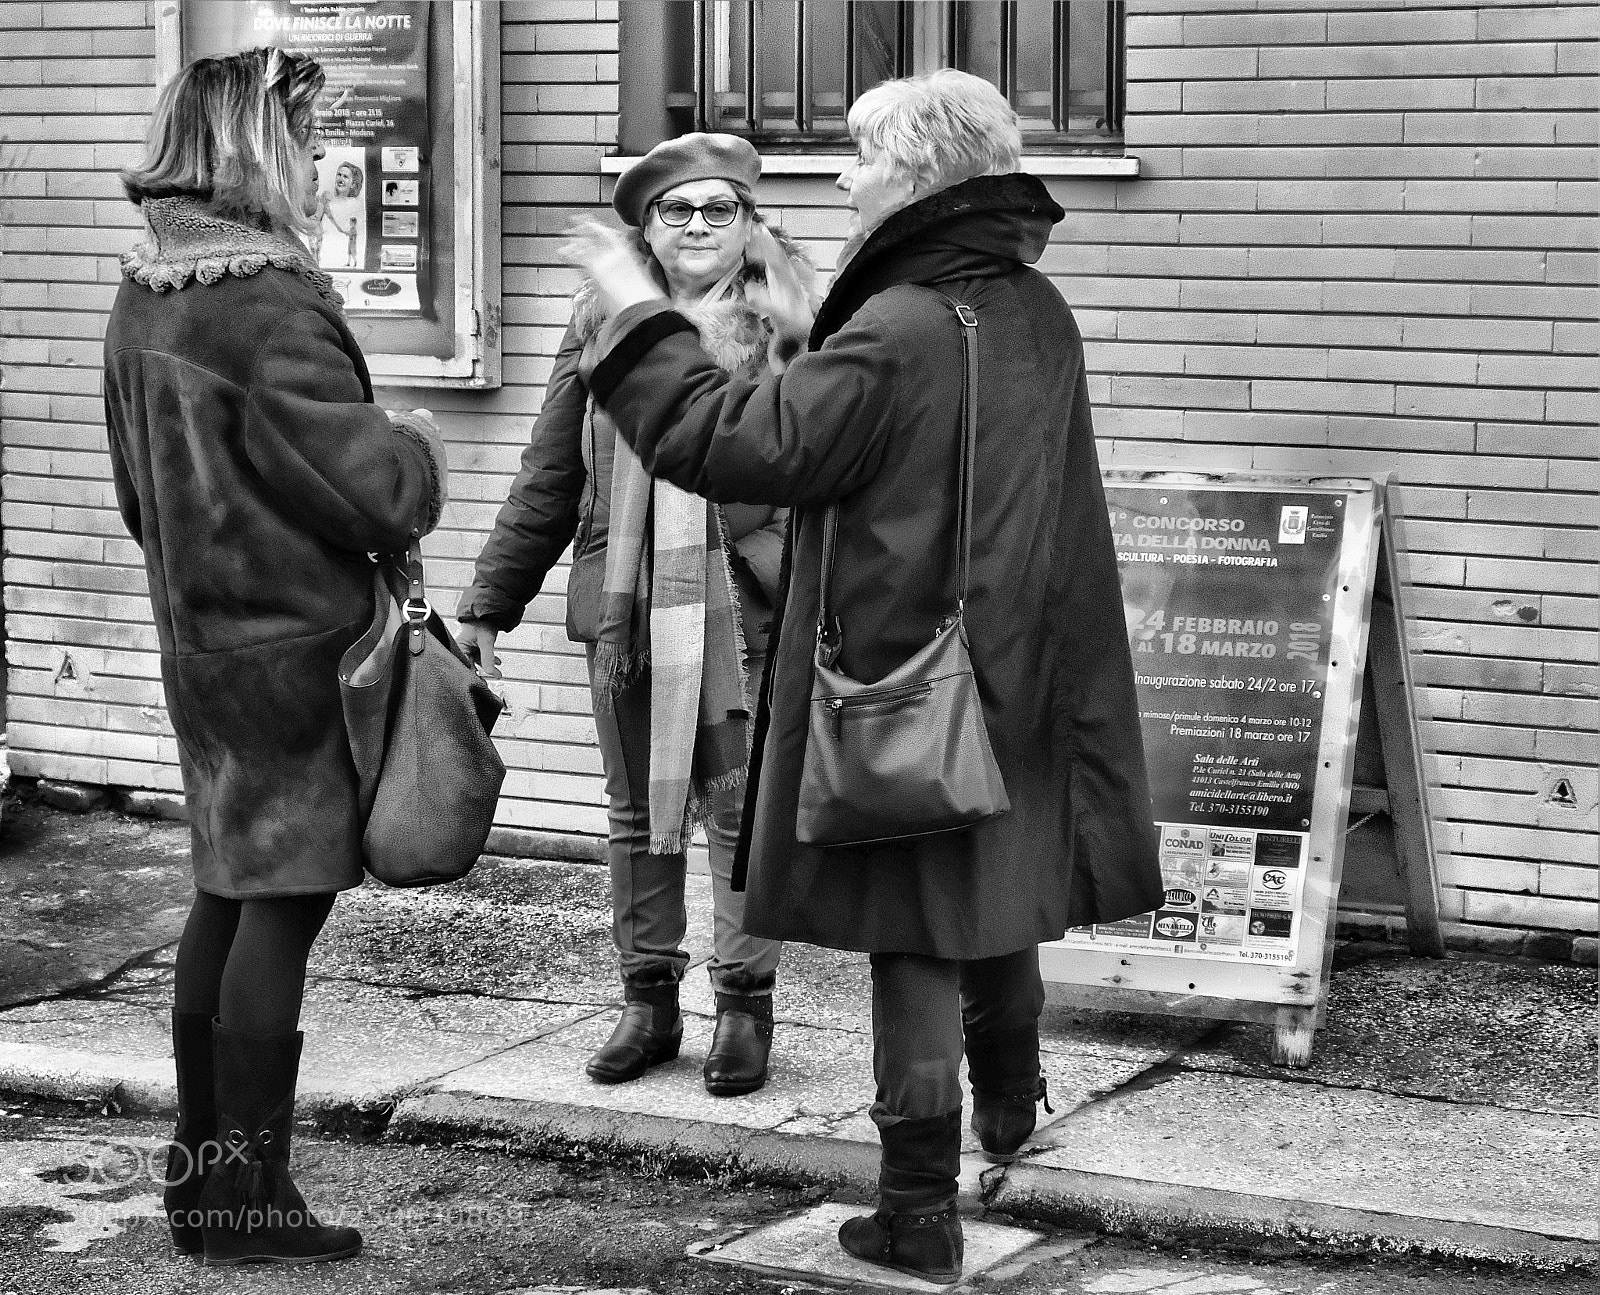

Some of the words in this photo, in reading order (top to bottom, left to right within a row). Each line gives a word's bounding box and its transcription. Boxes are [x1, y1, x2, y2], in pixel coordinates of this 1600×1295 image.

[253, 16, 291, 31] DOVE
[293, 15, 342, 30] FINISCE
[345, 15, 361, 29] LA
[365, 14, 412, 29] NOTTE
[288, 33, 300, 42] UN
[345, 32, 373, 41] GUERRA
[334, 108, 350, 117] 2018
[345, 119, 365, 127] Piazza
[325, 129, 345, 137] Emilia
[350, 129, 375, 137] Modena
[1133, 515, 1245, 532] CONCORSO
[1137, 534, 1198, 549] DELLA
[1200, 537, 1272, 551] DONNA
[1117, 552, 1164, 563] SCULTURA
[1173, 554, 1209, 565] POESIA
[1218, 556, 1278, 567] FOTOGRAFIA
[1173, 617, 1279, 635] FEBBRAIO
[1137, 641, 1154, 653] AL
[1160, 633, 1196, 655] 18
[1200, 640, 1277, 658] MARZO
[1286, 622, 1322, 661] 2018
[1134, 671, 1207, 690] Inaugurazione
[1209, 674, 1245, 690] sabato
[1247, 677, 1276, 693] 24/2
[1279, 681, 1297, 693] ore
[1301, 680, 1315, 694] 17
[1203, 712, 1239, 724] domenica
[1240, 714, 1247, 724] 4
[1248, 717, 1273, 726] marzo
[1274, 718, 1287, 727] ore
[1289, 717, 1312, 728] 10-12
[1170, 724, 1225, 739] Premiazioni
[1229, 727, 1242, 739] 18
[1244, 732, 1275, 741] marzo
[1277, 733, 1294, 743] ore
[1298, 731, 1311, 743] 17
[1193, 754, 1214, 764] Sala
[1216, 755, 1239, 766] delle
[1240, 757, 1260, 767] Arti
[1189, 789, 1293, 804] amicidellarte@libero.it
[1189, 801, 1206, 812] Tel.
[1208, 803, 1270, 817] 370-3155190
[1165, 838, 1204, 850] CONAD
[1239, 950, 1250, 959] Tel.
